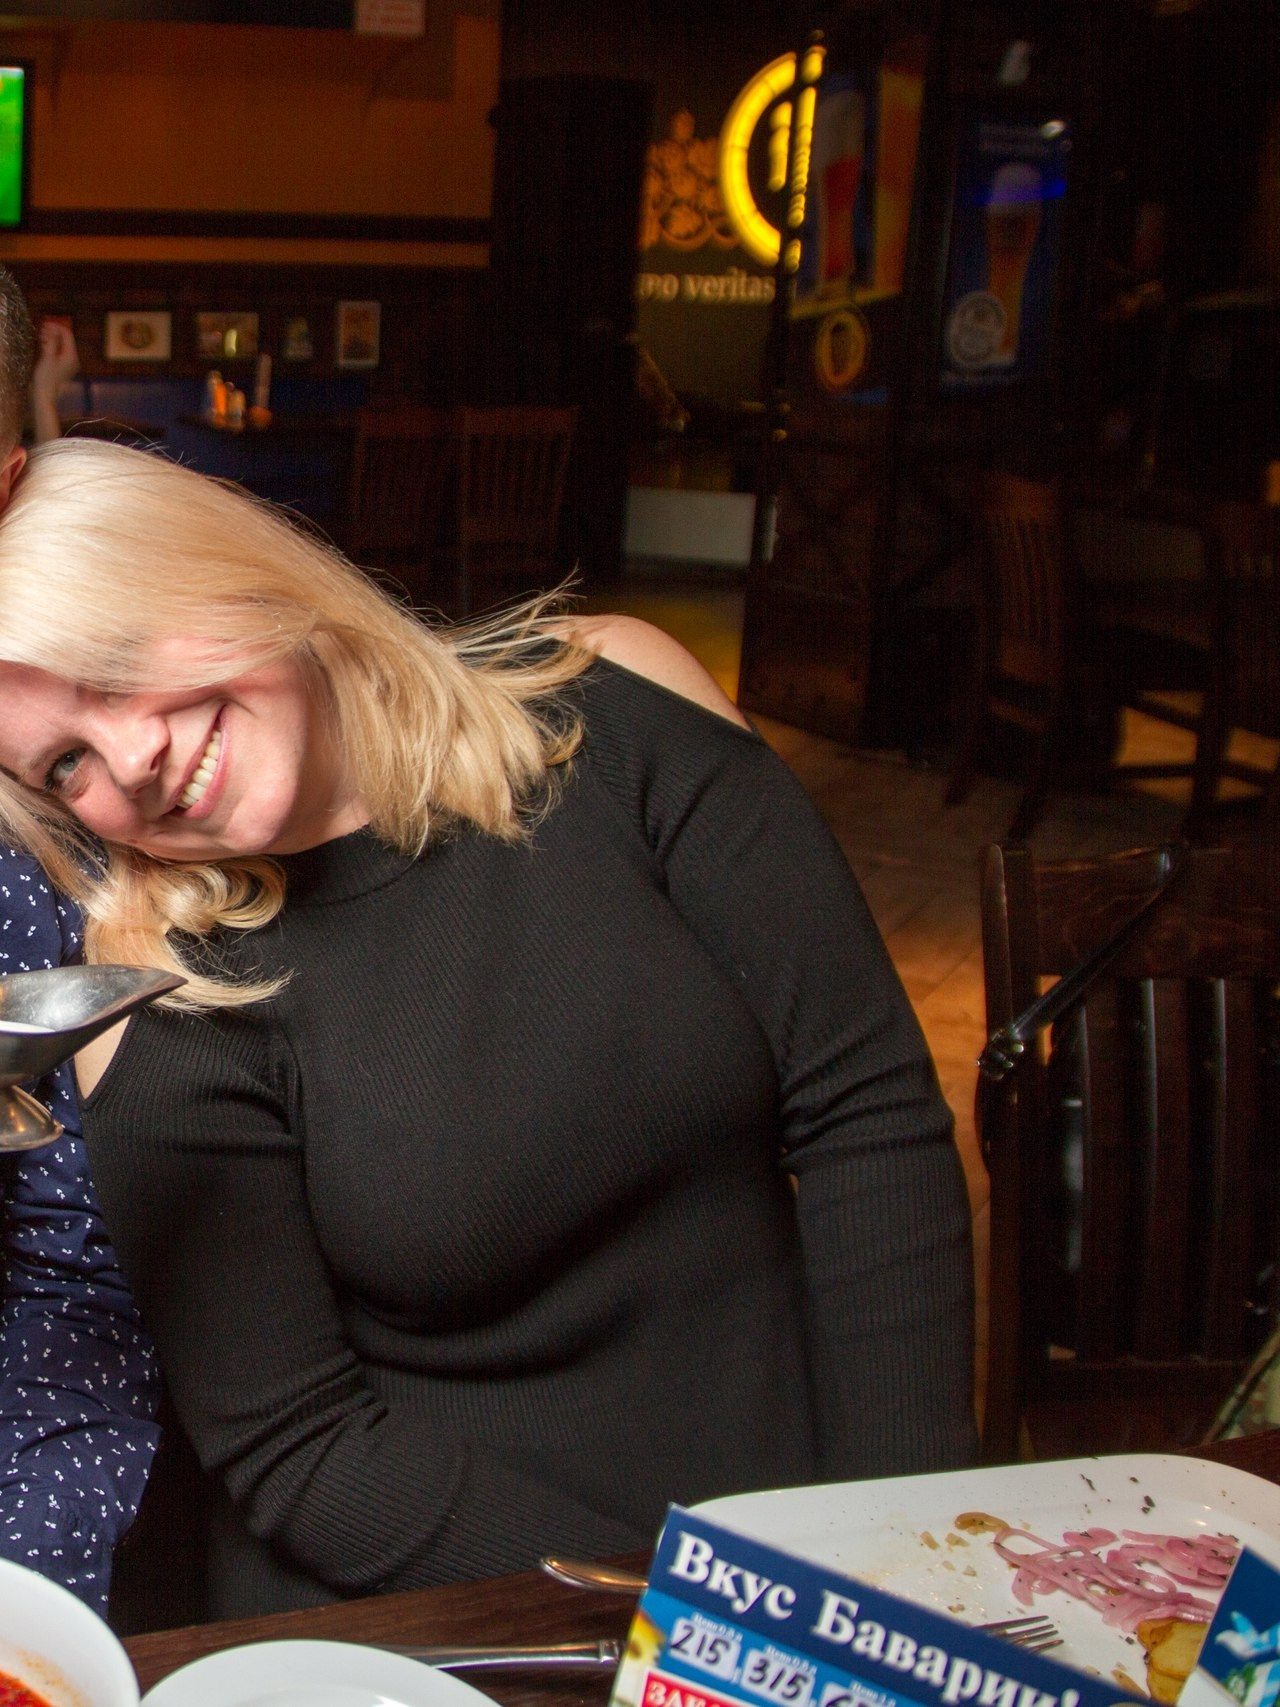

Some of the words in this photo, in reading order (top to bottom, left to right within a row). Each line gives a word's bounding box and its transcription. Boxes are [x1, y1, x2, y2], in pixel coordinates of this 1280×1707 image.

[683, 266, 776, 302] veritas
[668, 1530, 797, 1620] Вкус
[670, 1625, 731, 1665] 215
[749, 1658, 810, 1699] 315
